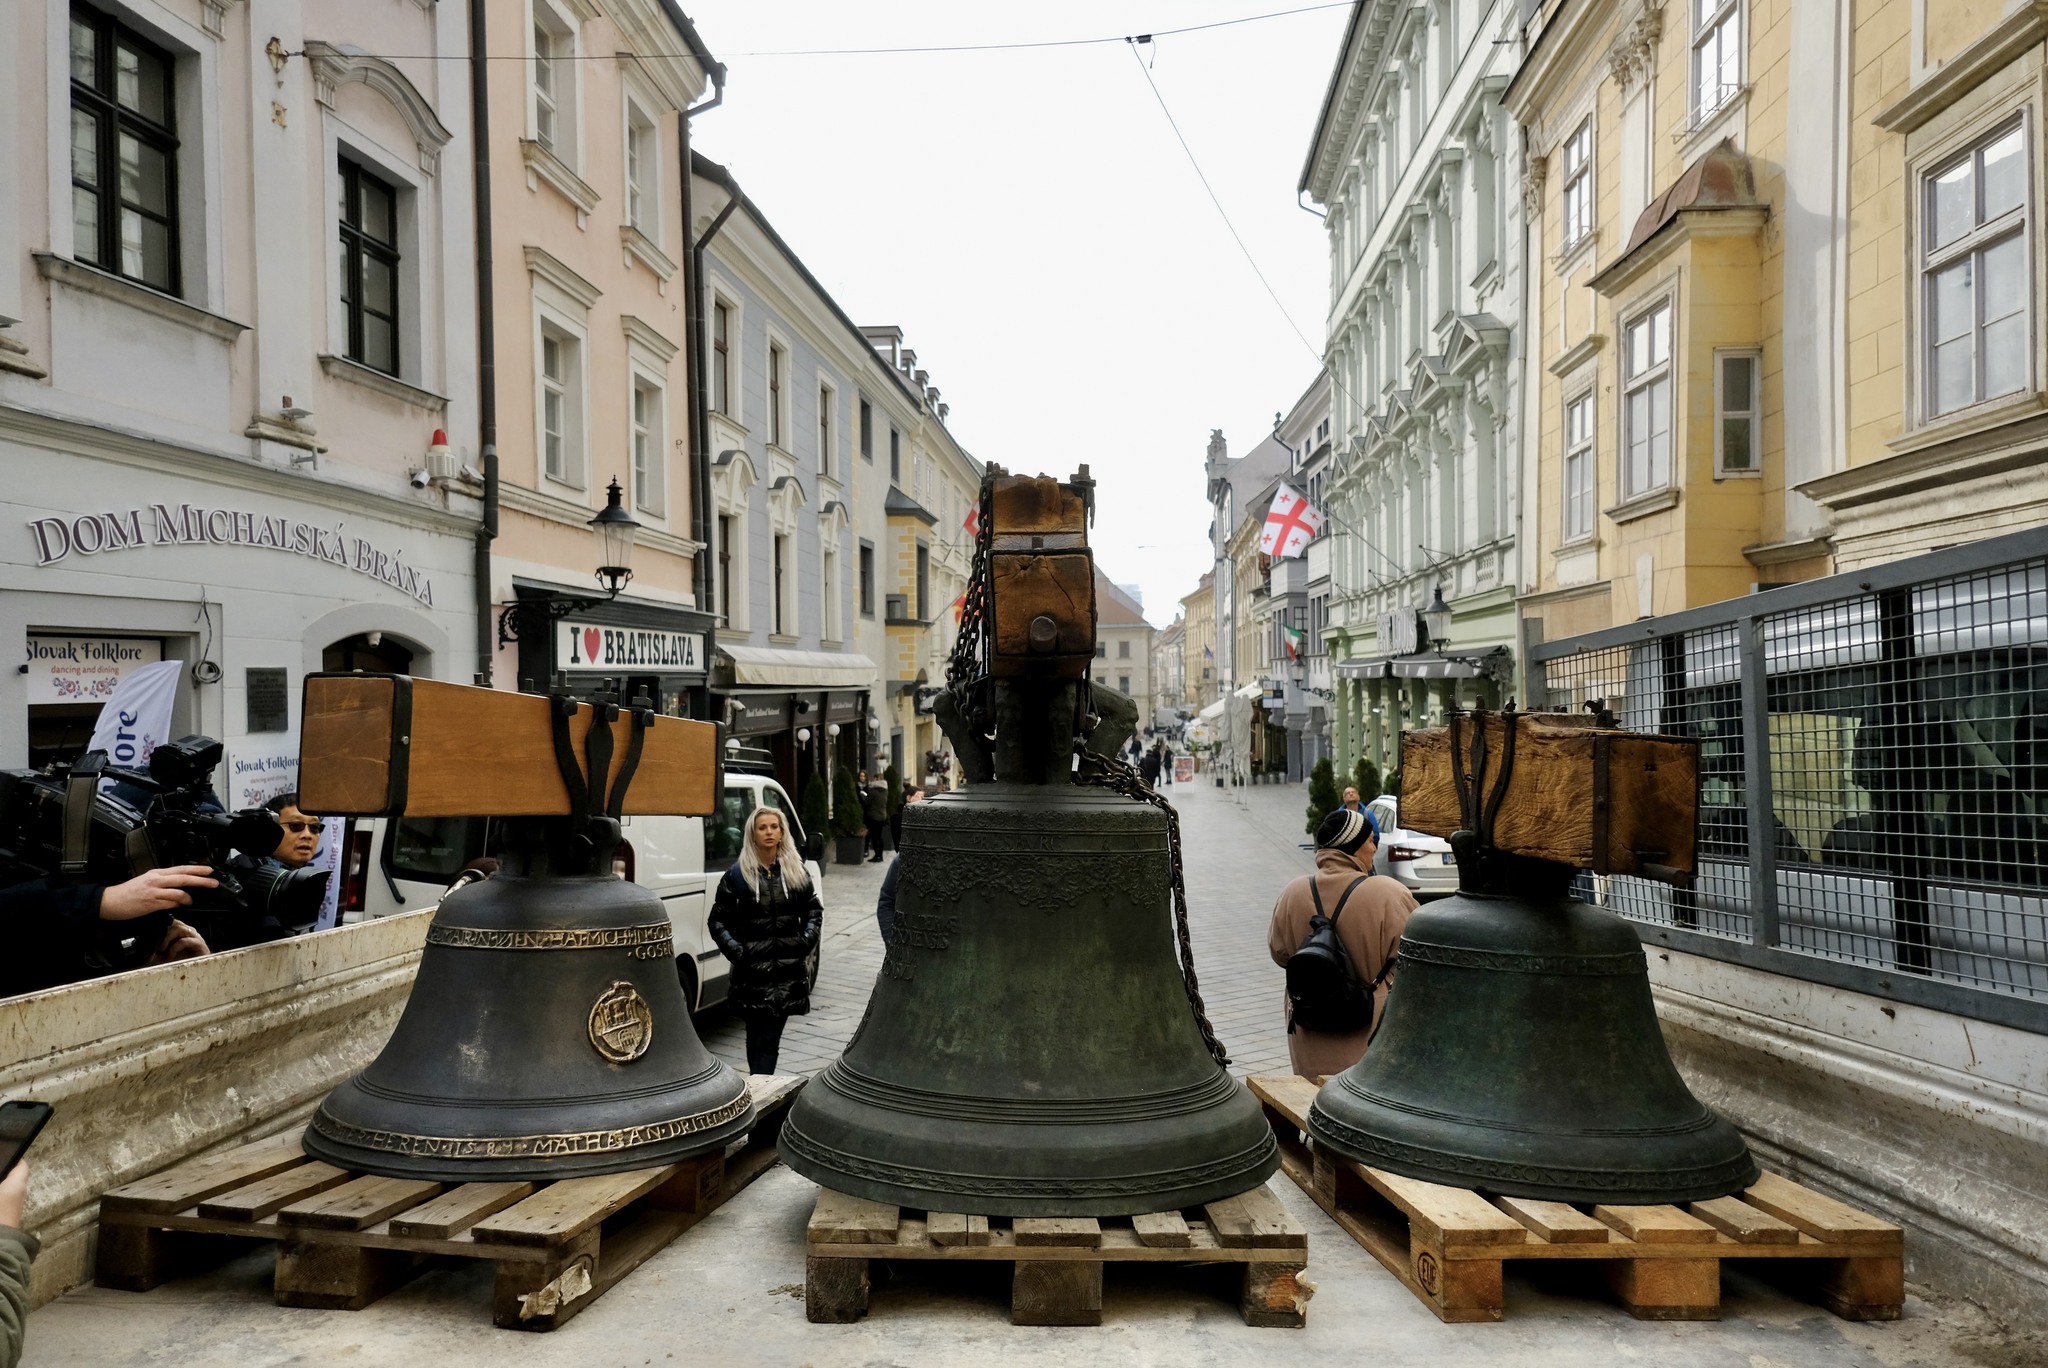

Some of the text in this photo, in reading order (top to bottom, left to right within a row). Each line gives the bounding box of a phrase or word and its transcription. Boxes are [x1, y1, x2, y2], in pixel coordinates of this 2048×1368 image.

[30, 503, 433, 607] DOM MICHALSKÁ BRÁNA
[27, 640, 142, 664] Slovak Folklore
[570, 626, 694, 666] I BRATISLAVA
[51, 664, 120, 676] dancing and dining
[235, 759, 265, 775] Slovak
